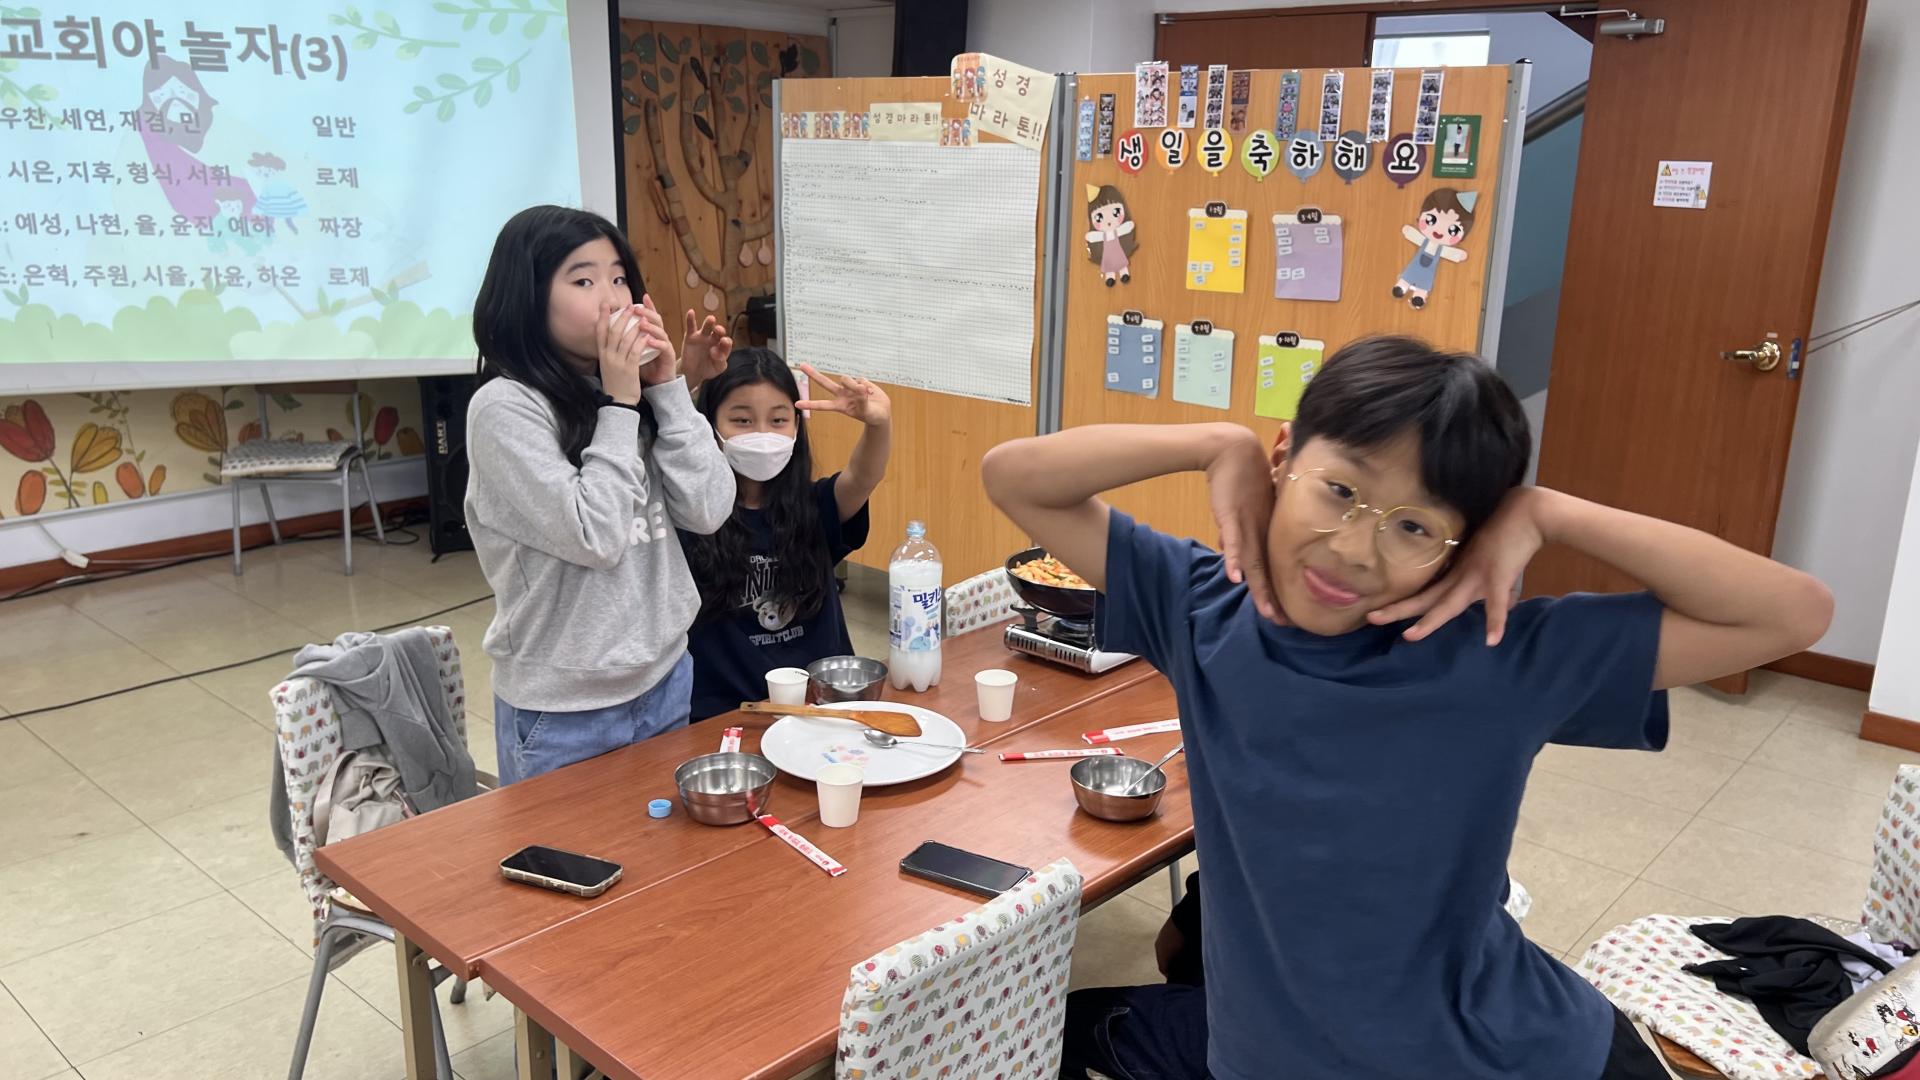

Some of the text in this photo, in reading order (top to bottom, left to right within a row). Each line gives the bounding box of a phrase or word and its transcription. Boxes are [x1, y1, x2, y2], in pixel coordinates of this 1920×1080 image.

[1, 16, 349, 82] 교회야 놀자(3)
[60, 108, 115, 133] 세연,
[312, 115, 356, 138] 일반
[8, 160, 359, 189] 시은, 지후, 형식, 서휘 로제
[15, 213, 70, 237] 예성,
[76, 213, 130, 237] 나현,
[135, 214, 165, 237] 율,
[170, 214, 223, 239] 윤진,
[319, 217, 362, 239] 짜장
[23, 264, 78, 288] 은혁,
[83, 265, 137, 288] 주원,
[143, 265, 195, 288] 시율,
[200, 265, 253, 288] 가윤,
[257, 265, 302, 288] 하온
[327, 267, 370, 287] 로제
